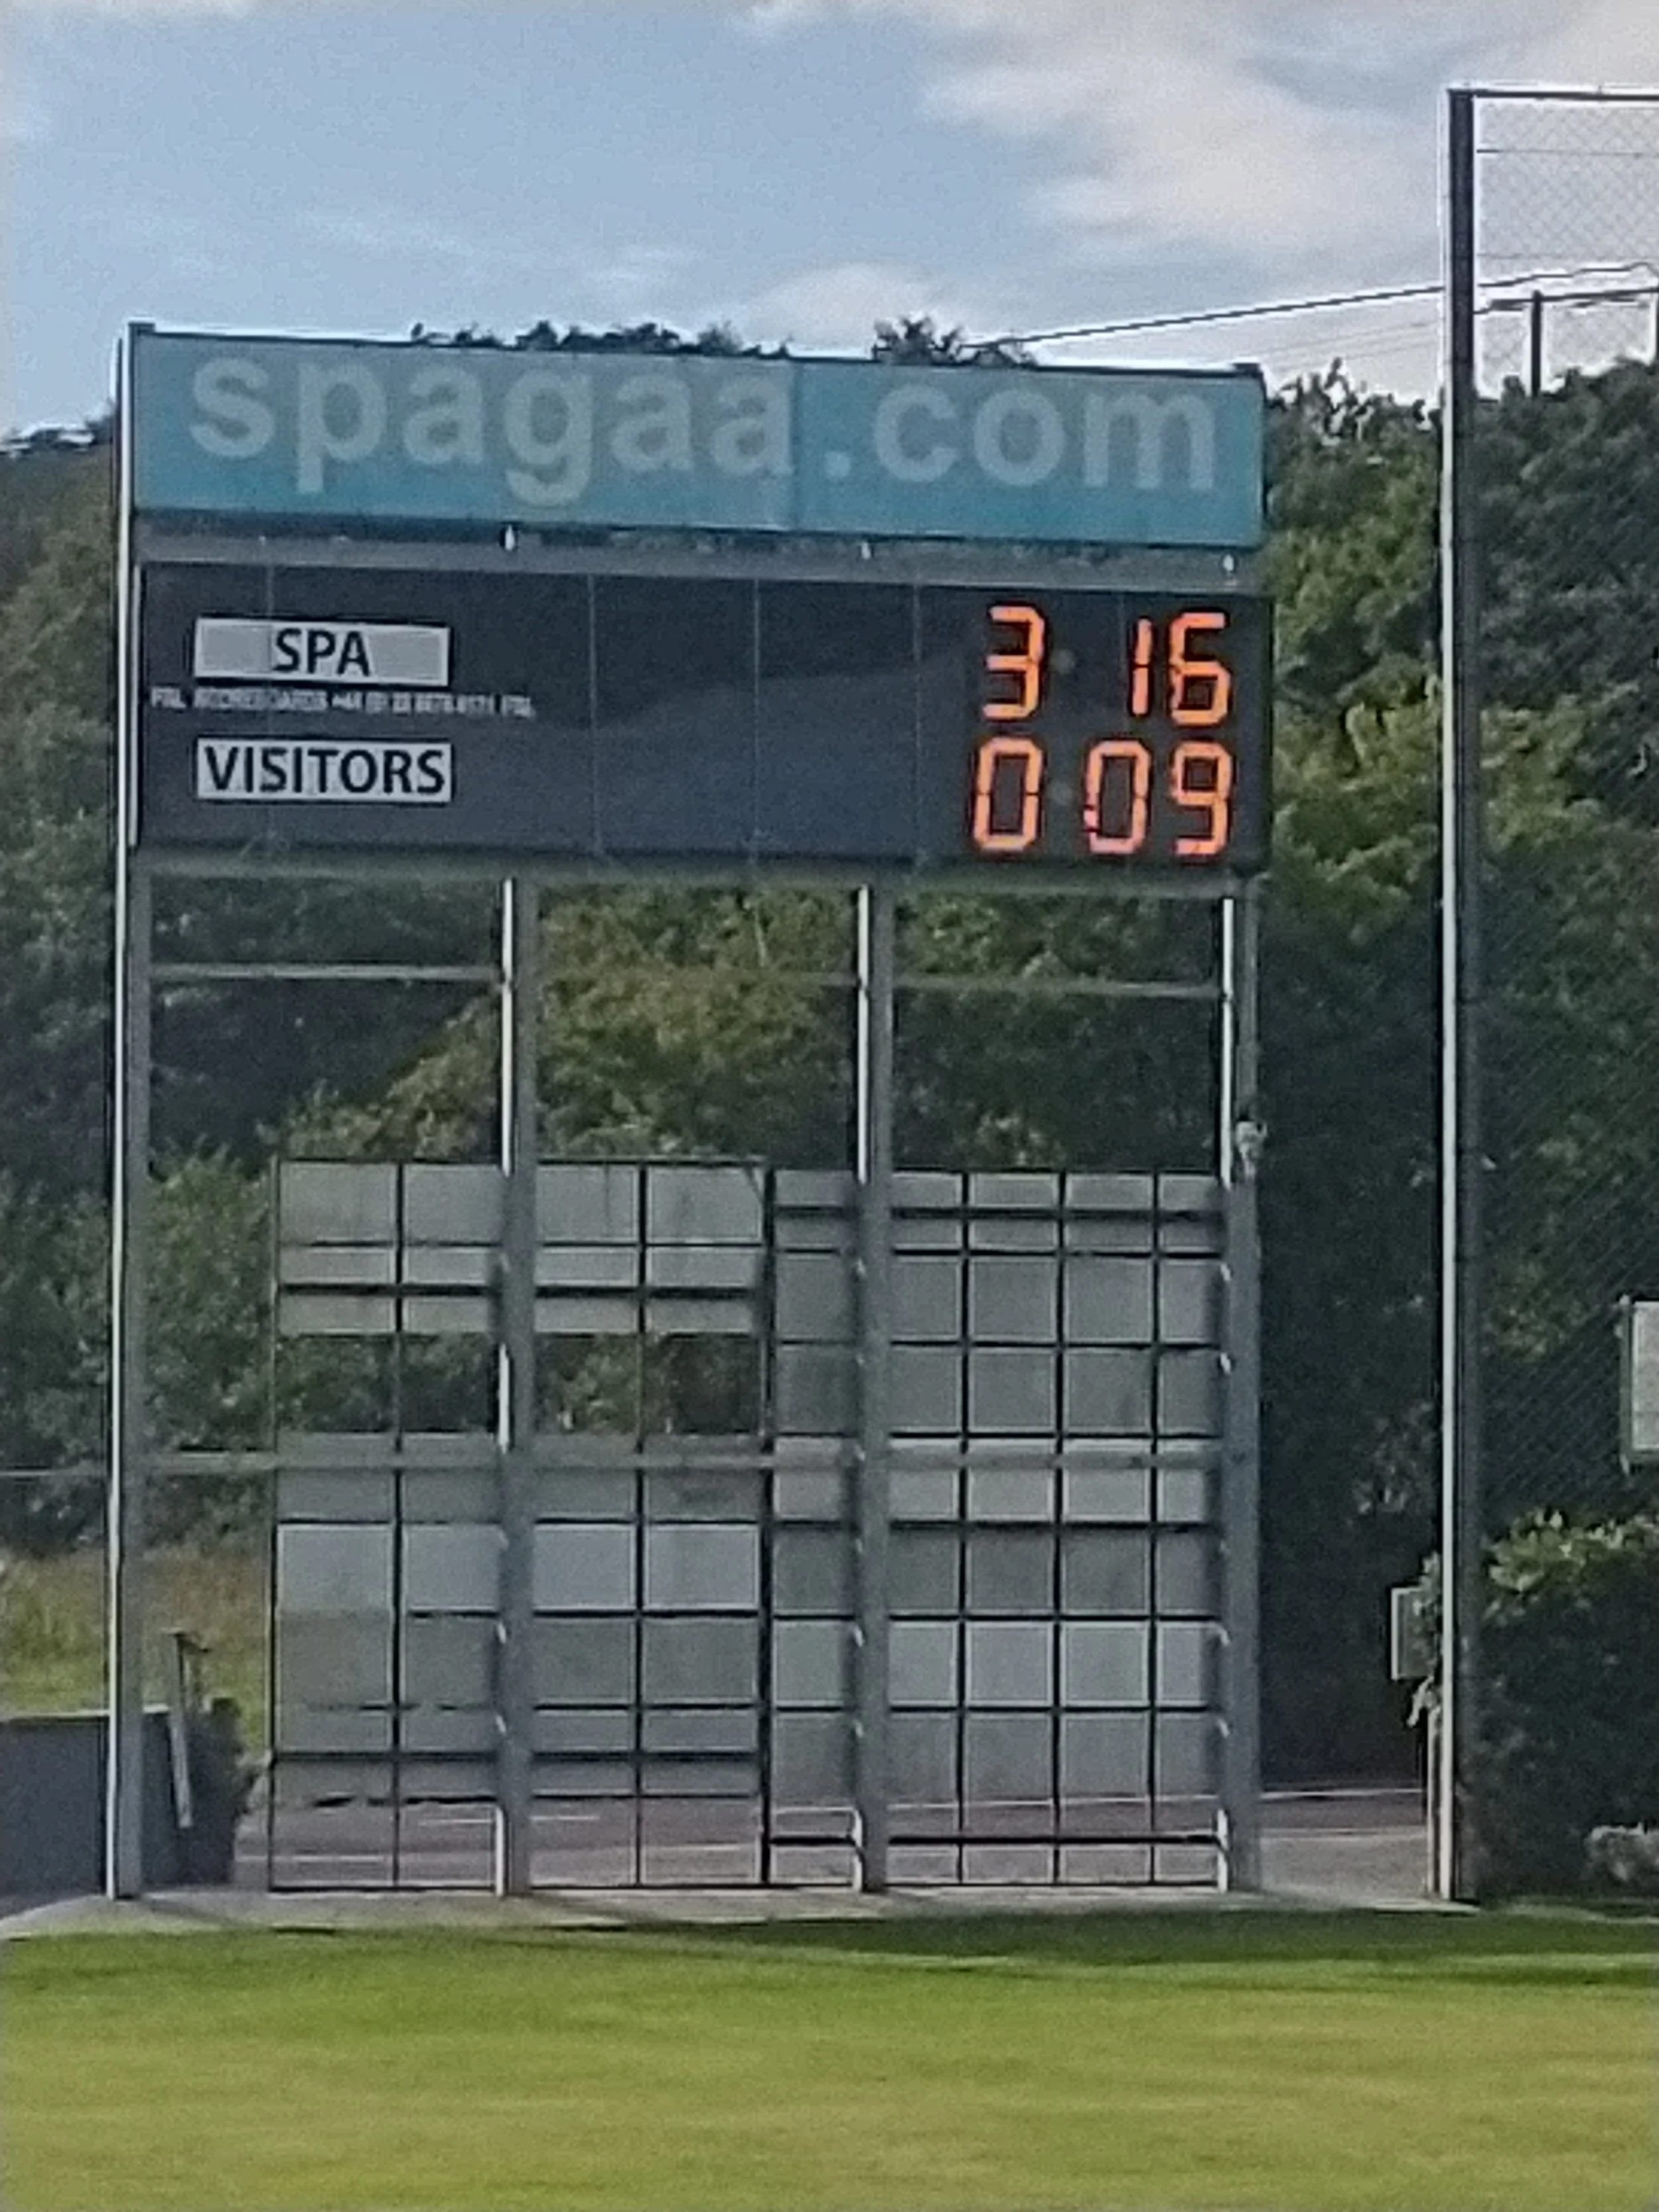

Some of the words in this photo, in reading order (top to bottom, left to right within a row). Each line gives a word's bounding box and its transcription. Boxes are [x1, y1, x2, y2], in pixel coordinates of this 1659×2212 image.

[190, 356, 1216, 507] spagaa.com
[273, 628, 370, 677] SPA
[983, 605, 1046, 719] 3
[1131, 612, 1231, 726] 16
[206, 745, 445, 795] VISITORS
[973, 737, 1045, 852] 0
[1083, 739, 1233, 857] 09
